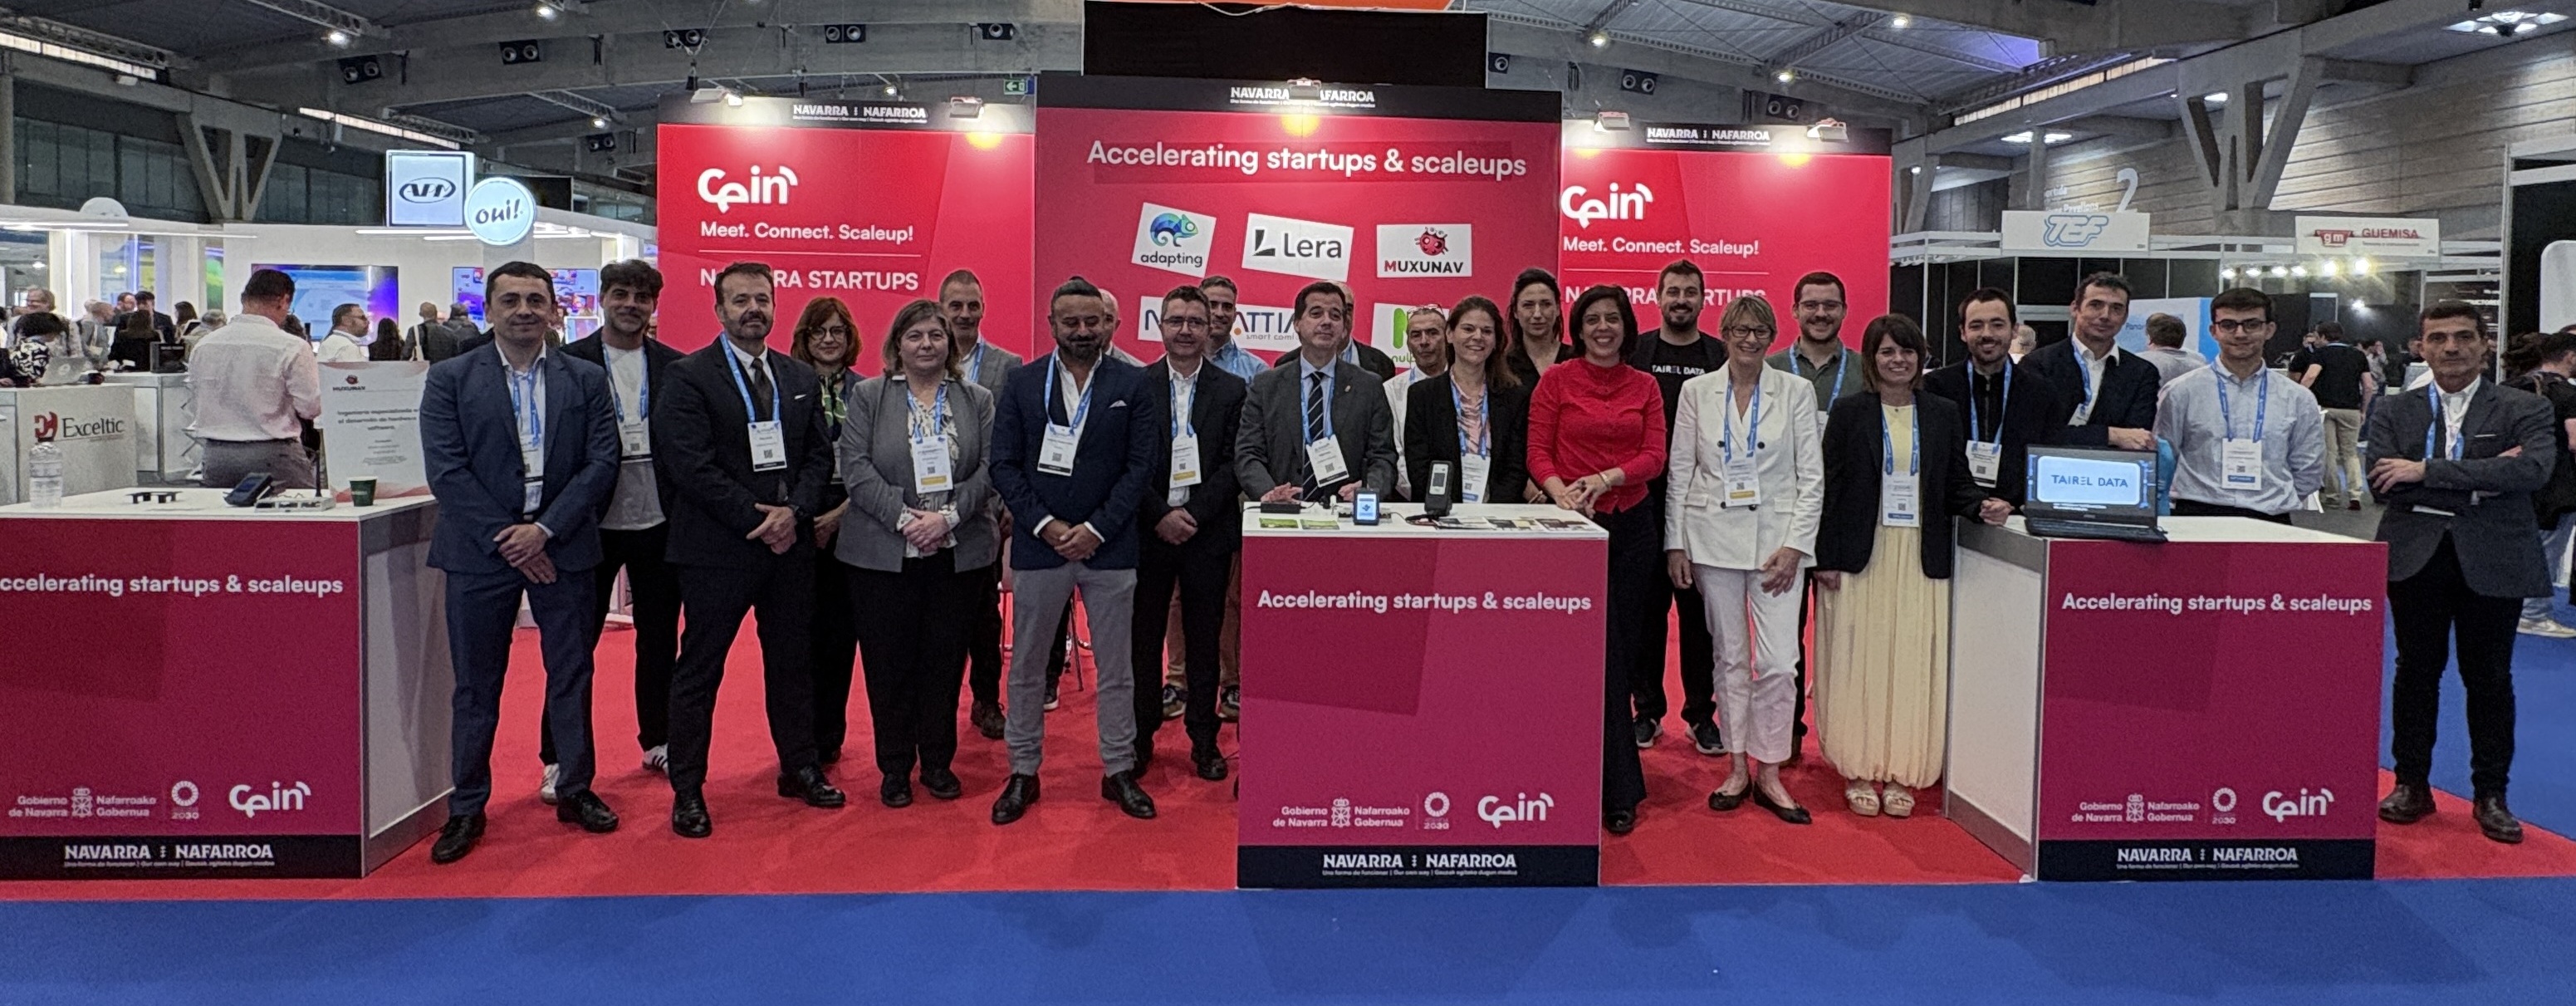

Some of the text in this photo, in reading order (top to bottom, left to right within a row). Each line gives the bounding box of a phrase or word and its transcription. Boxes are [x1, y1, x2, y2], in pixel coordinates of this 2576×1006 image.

[1230, 86, 1375, 102] NAVARRA FARROA
[793, 105, 927, 118] NAVARRA NAFARROA
[1647, 127, 1770, 140] NAVARRA NAFARROA
[1087, 140, 1526, 182] Accelerating startups & scaleups
[2117, 168, 2138, 213] 2
[476, 199, 521, 224] oui!
[701, 221, 913, 245] Meet. Connect. Scaleup!
[2044, 214, 2108, 247] TEF
[2362, 228, 2419, 239] GUEMISA
[1283, 232, 1342, 259] Lera
[1563, 237, 1759, 258] Meet. Connect. Scaleup!
[1140, 250, 1203, 268] adapting
[1383, 258, 1463, 275] MUXUNAV
[808, 270, 919, 291] STARTUPS
[1683, 366, 1706, 375] DATA
[61, 417, 126, 438] Exceltic
[2098, 477, 2128, 488] DATA
[0, 573, 344, 598] ccelerating startups & scaleups
[1257, 590, 1592, 615] Accelerating startups & scaleups
[2062, 592, 2373, 616] Accelerating startups & scaleups
[17, 795, 157, 805] Gobierno Nafarroako
[2079, 802, 2200, 811] Gobierno Nafarroako
[8, 807, 150, 817] de Navarra Gobernua
[171, 811, 200, 820] 2030
[1281, 806, 1410, 816] Gobierno Nafarroako
[2071, 813, 2193, 822] de Navarra Gobernua
[1272, 817, 1403, 827] de Navarra Gobernua
[1423, 822, 1450, 830] 2030
[65, 844, 274, 859] NAVARRA NAFARROA
[2118, 847, 2299, 861] NAVARRA NAFARROA
[1323, 854, 1517, 868] NAVARRA NAFARROA
